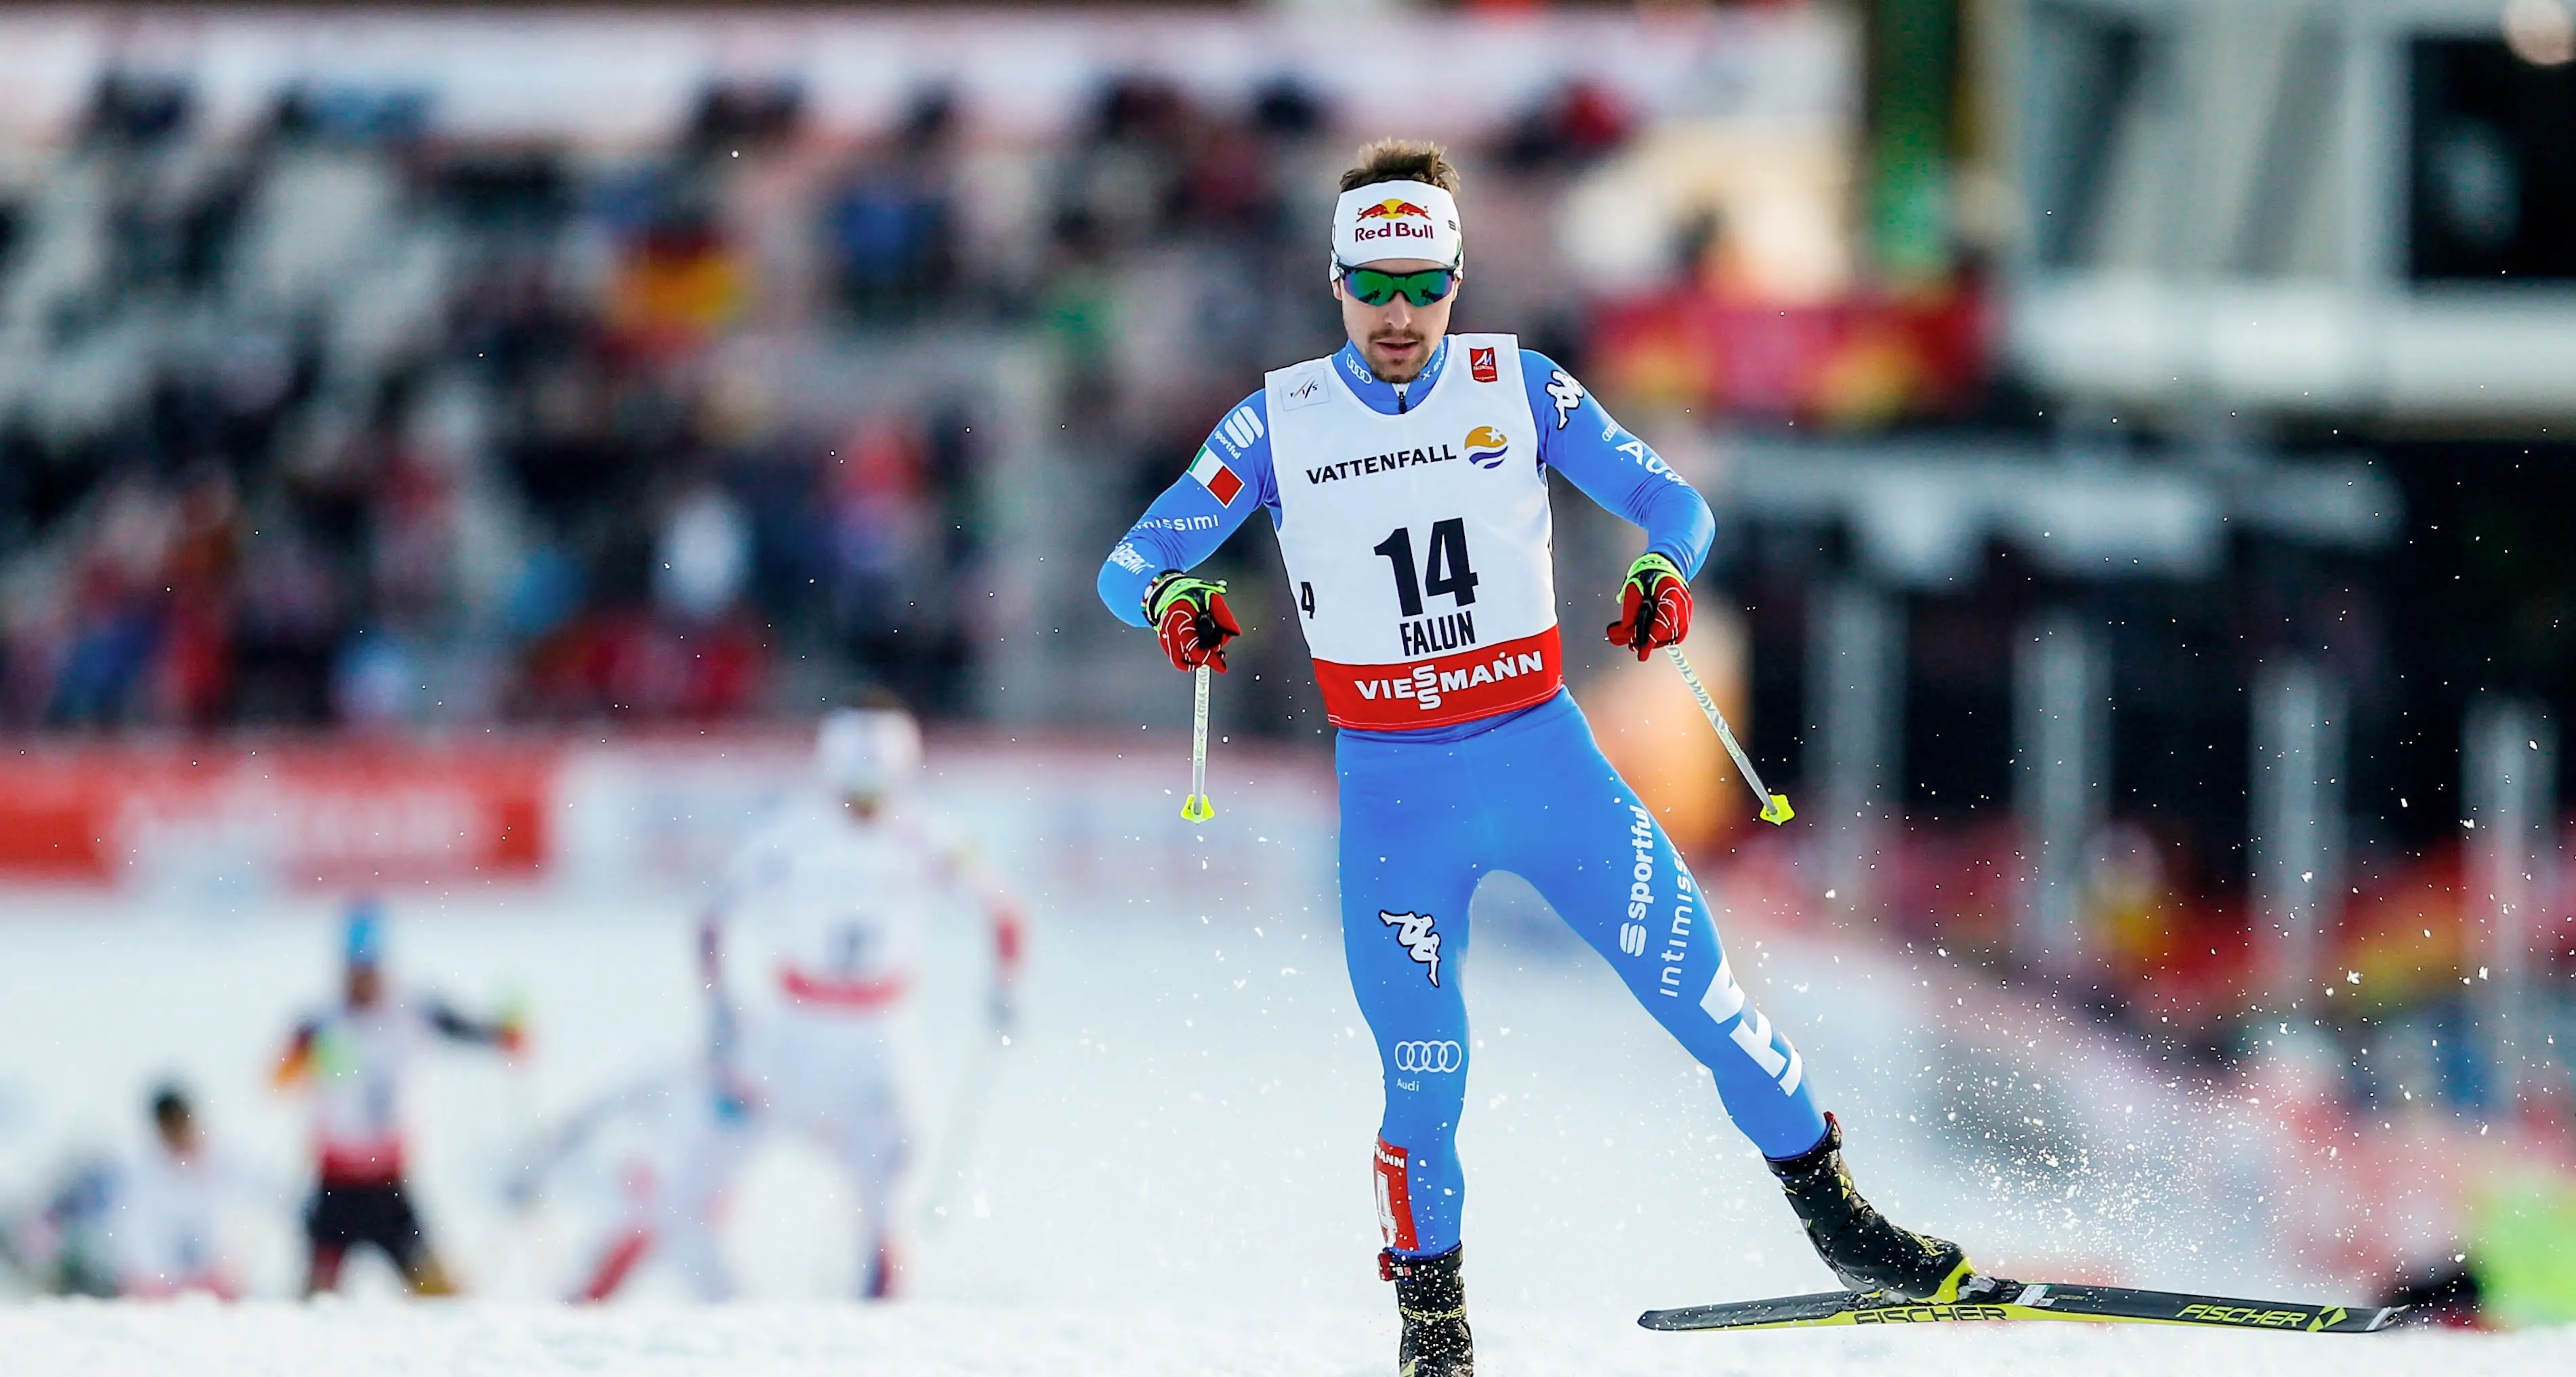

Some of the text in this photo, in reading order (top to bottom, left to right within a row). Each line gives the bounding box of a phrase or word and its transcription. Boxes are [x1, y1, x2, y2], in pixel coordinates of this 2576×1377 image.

[1355, 222, 1390, 242] Red
[1396, 222, 1434, 240] Bull
[1214, 430, 1241, 459] sportful
[1306, 444, 1457, 484] VATTENFALL
[1373, 517, 1478, 617] 14
[1301, 581, 1315, 619] 4
[1400, 610, 1476, 657] FALUN
[1354, 650, 1543, 710] VIESSMANN
[1627, 804, 1654, 920] sportful
[1396, 1078, 1419, 1092] Audi
[1854, 1307, 2006, 1325] FISCHER
[2175, 1303, 2308, 1328] FISCHER
